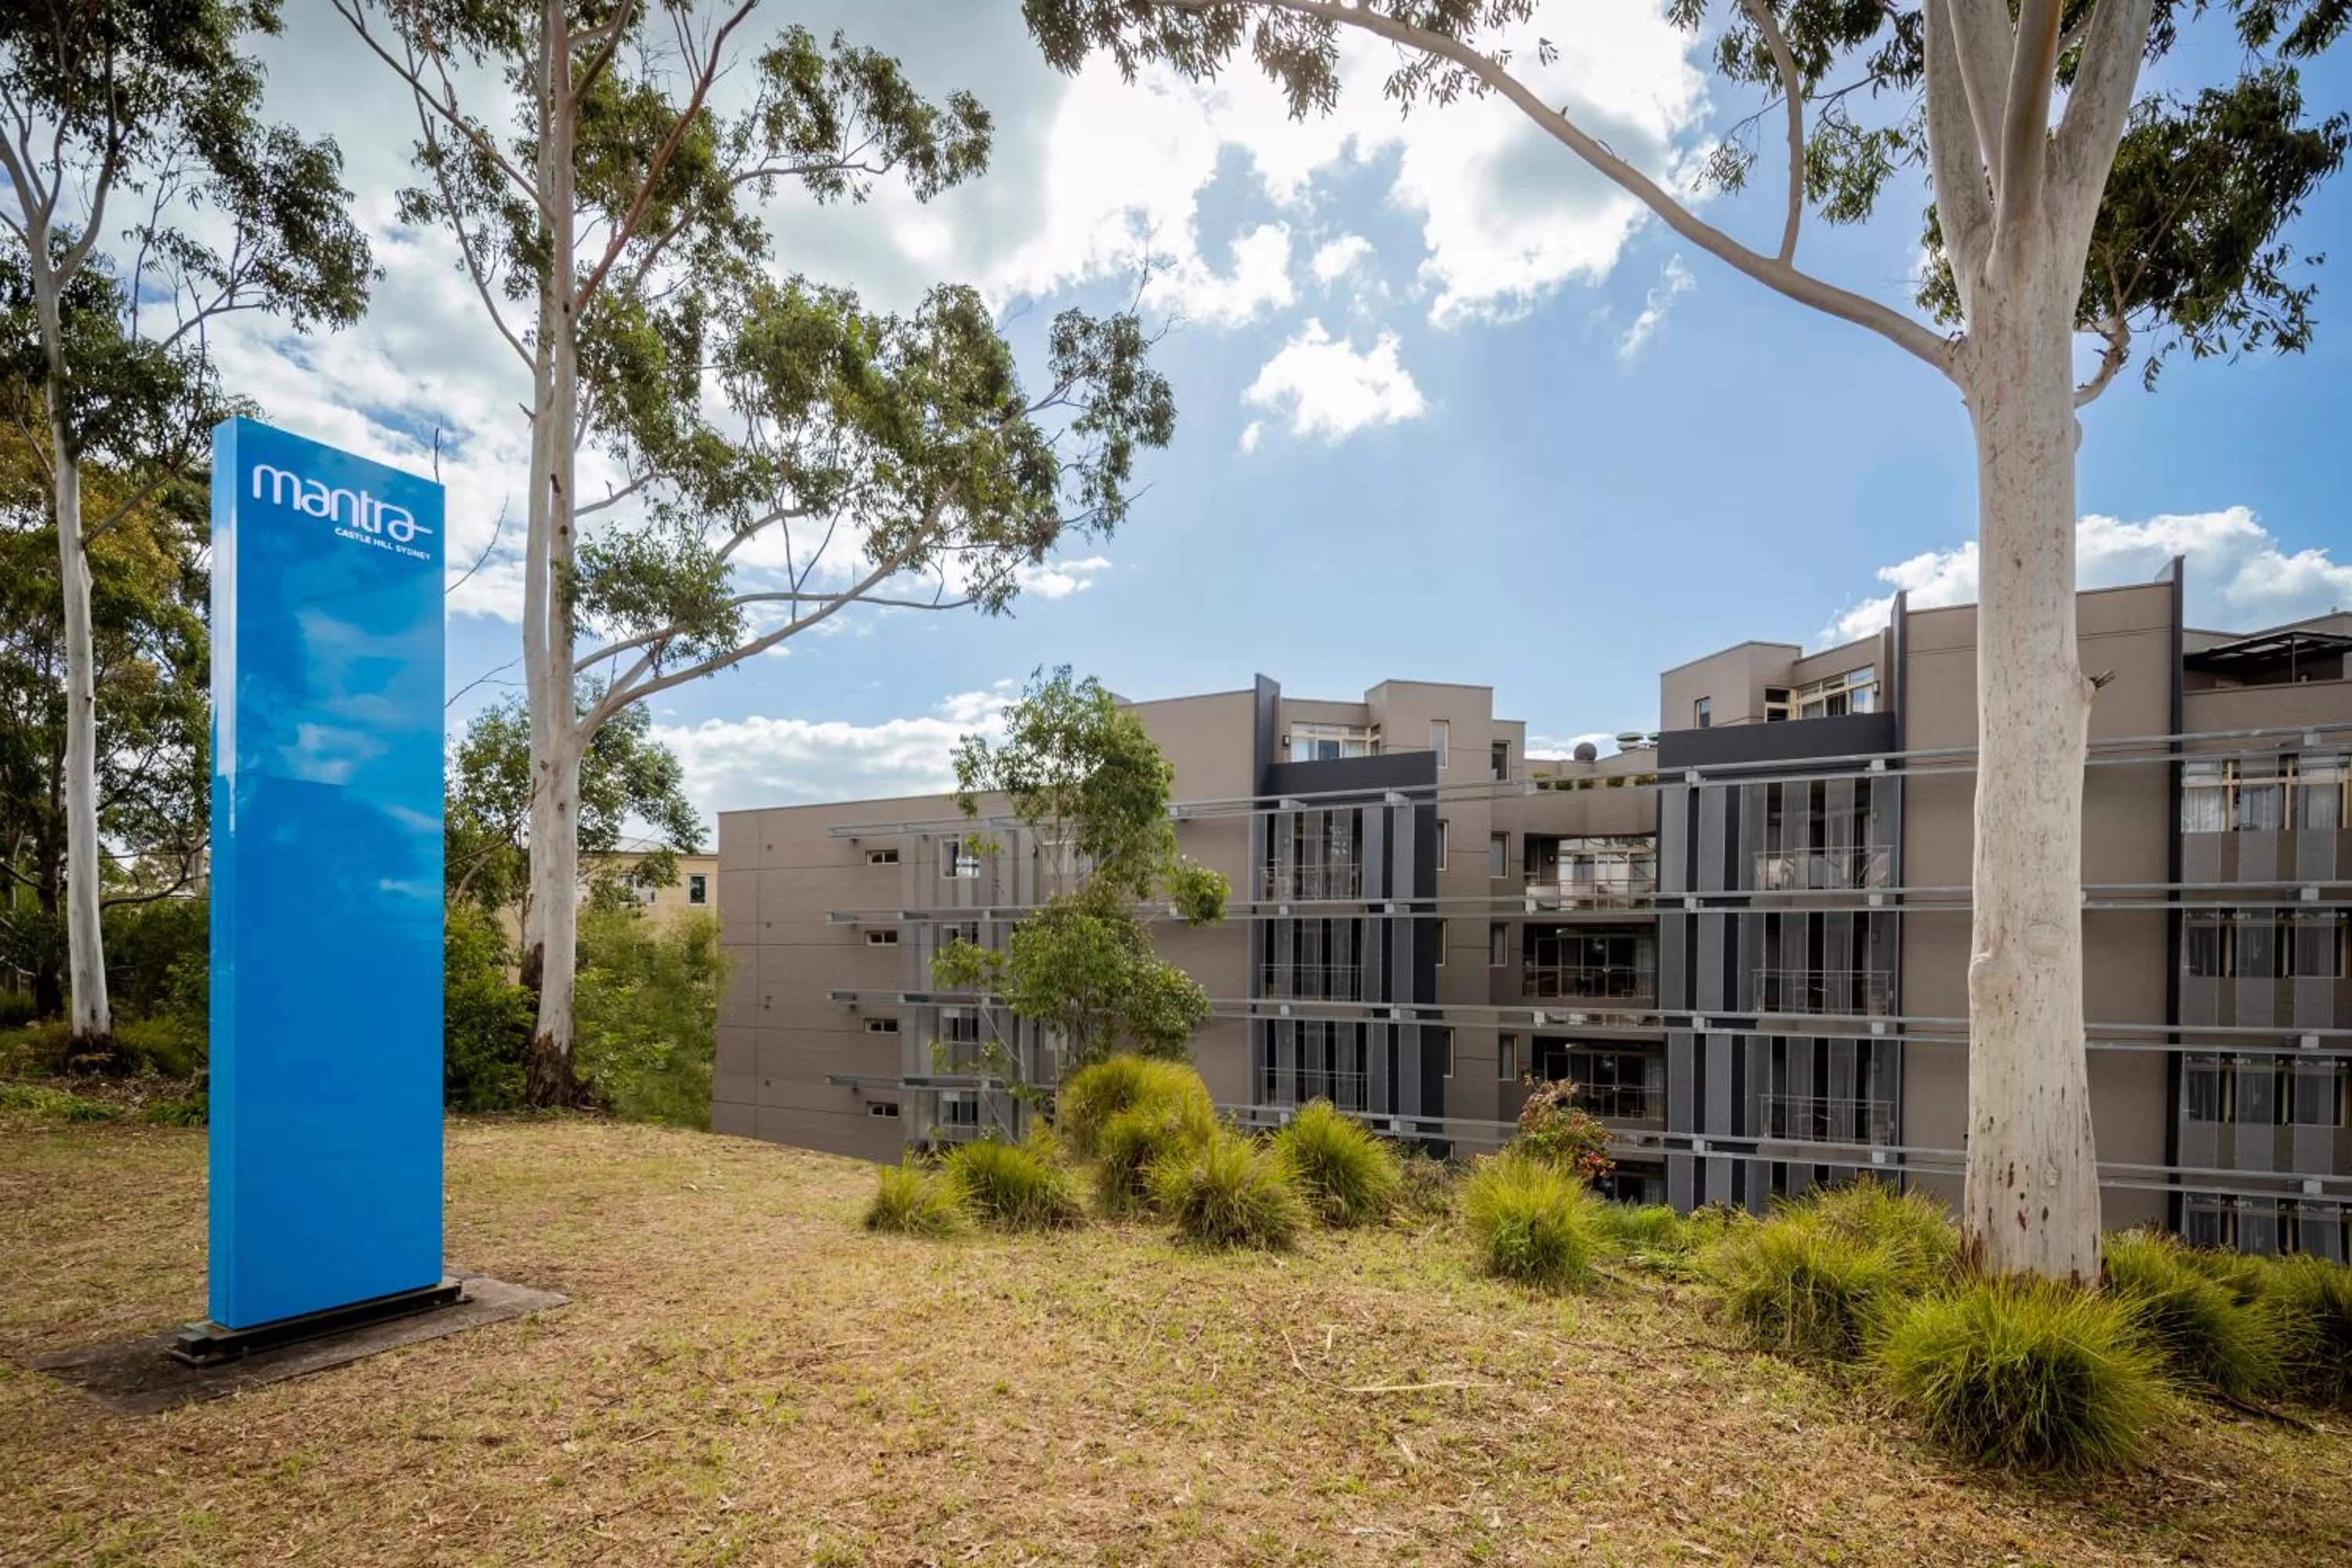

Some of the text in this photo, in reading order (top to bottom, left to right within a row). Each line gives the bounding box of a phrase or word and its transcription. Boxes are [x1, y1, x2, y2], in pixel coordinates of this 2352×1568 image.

[252, 464, 433, 543] mantra
[335, 527, 431, 561] CASTLE HILL SYDNEY
